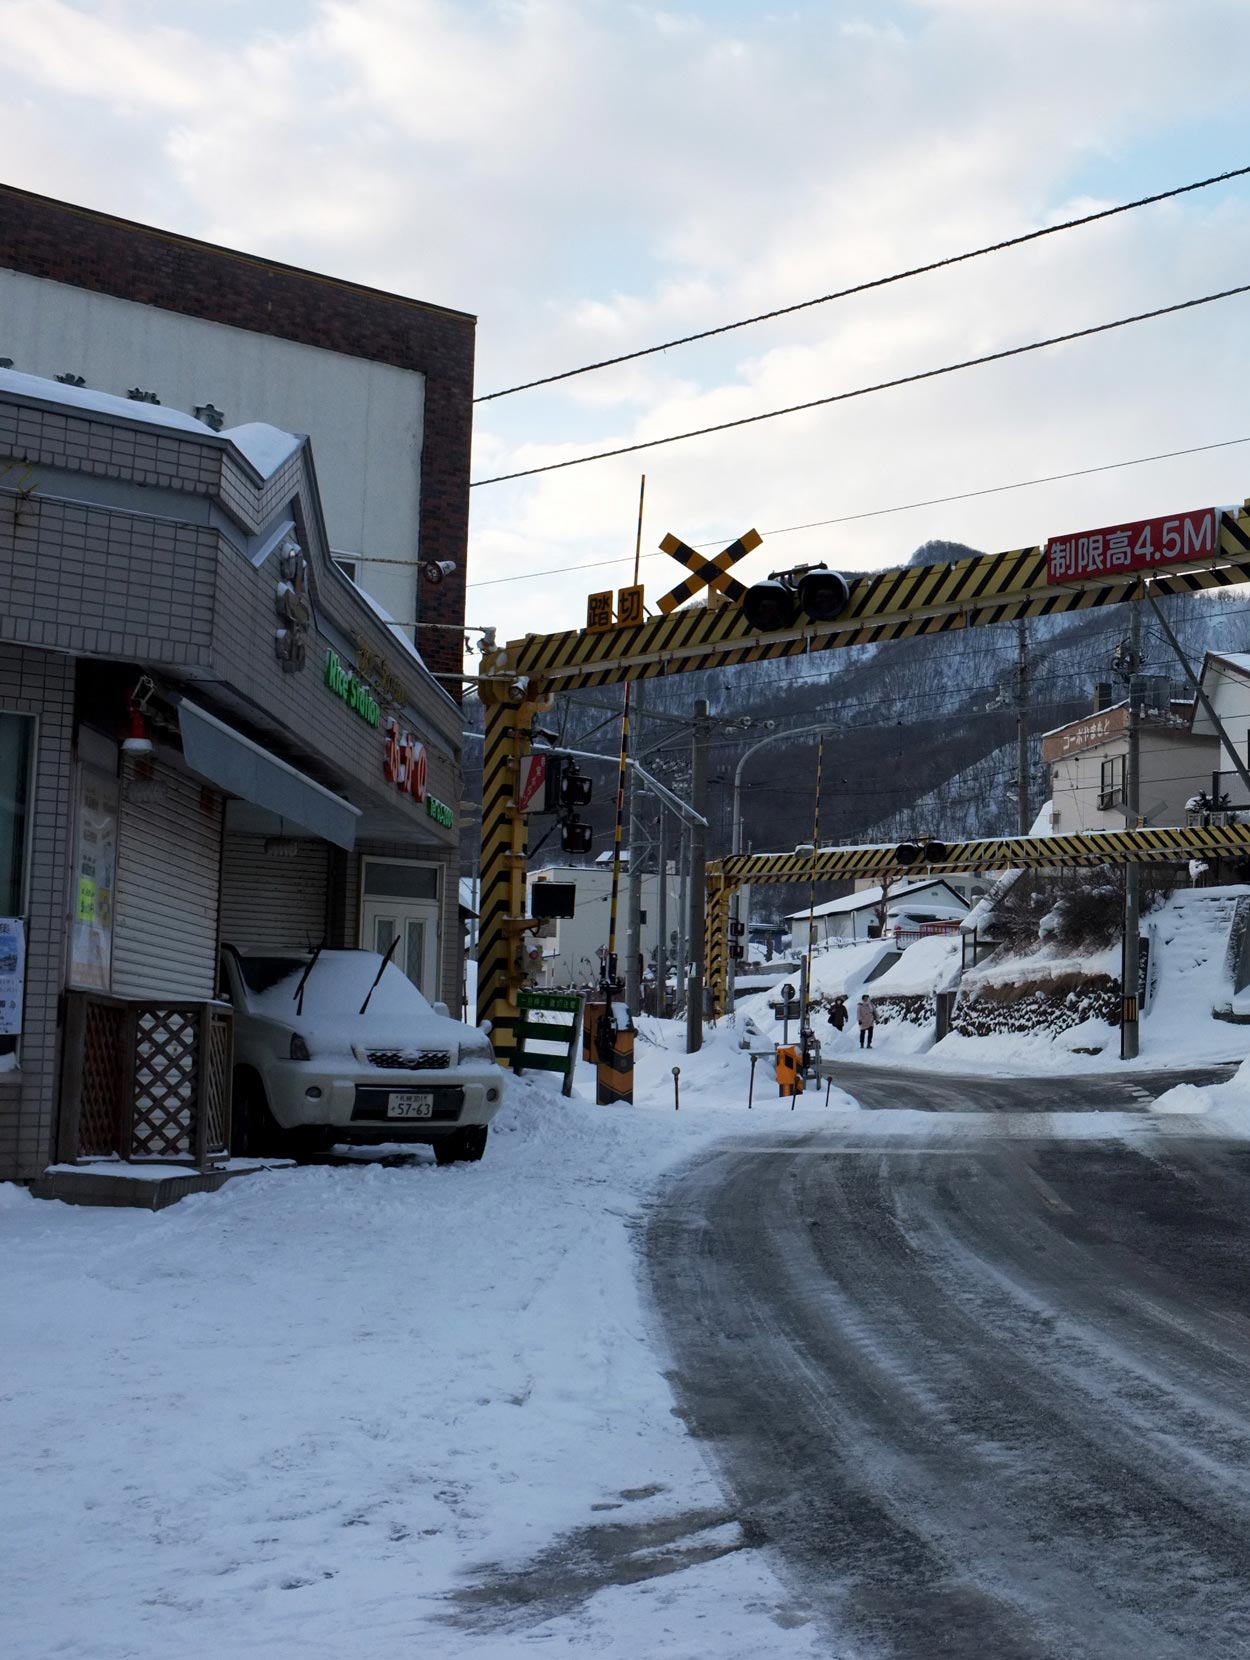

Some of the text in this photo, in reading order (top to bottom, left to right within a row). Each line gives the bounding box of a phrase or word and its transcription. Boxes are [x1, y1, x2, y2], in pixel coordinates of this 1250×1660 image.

[1050, 513, 1213, 578] 制限高4.5M
[589, 590, 642, 627] 踏切
[326, 647, 350, 702] Rice
[1063, 718, 1110, 750] コーポやまもと
[398, 1103, 431, 1115] 57-63
